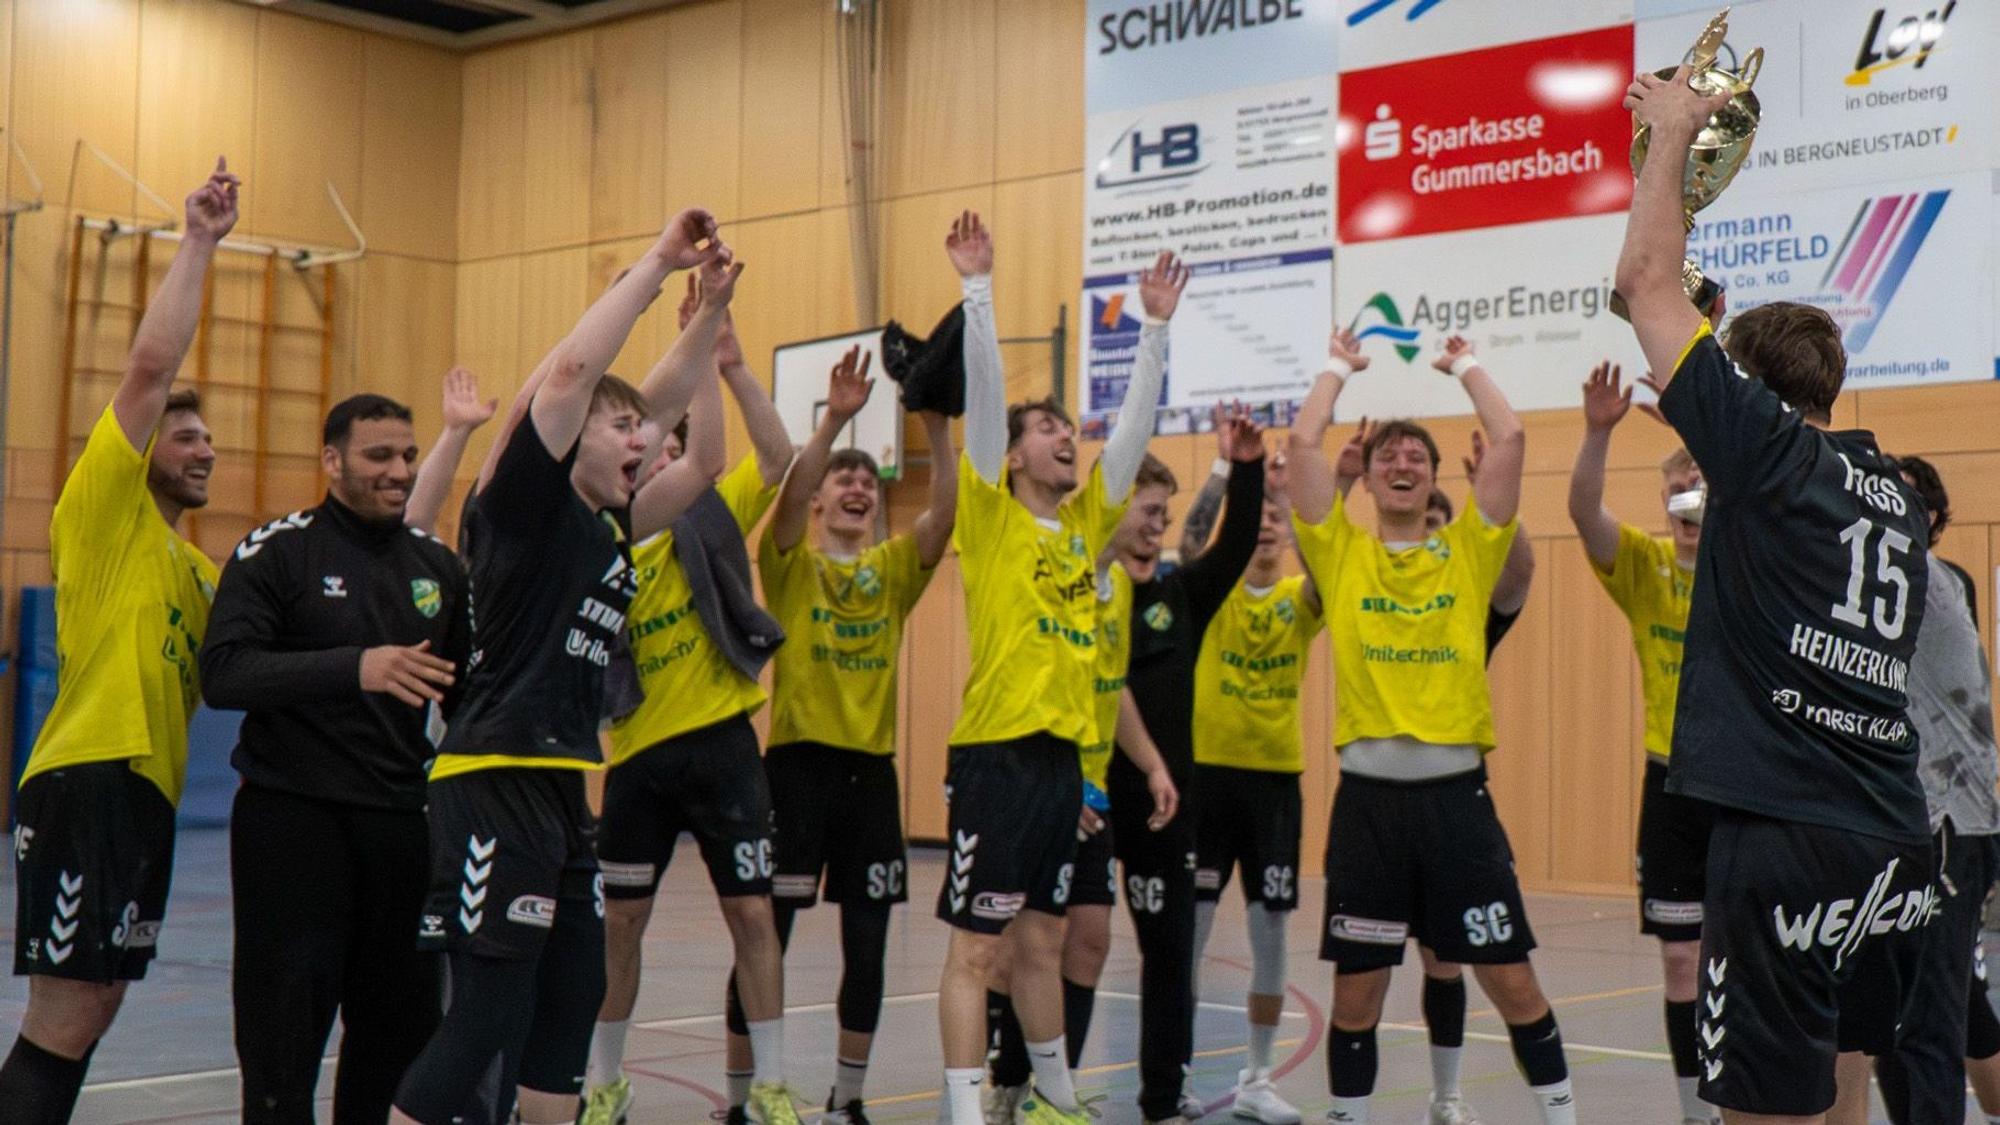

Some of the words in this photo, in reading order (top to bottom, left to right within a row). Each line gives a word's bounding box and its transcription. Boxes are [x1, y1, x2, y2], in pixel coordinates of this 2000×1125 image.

[1098, 0, 1303, 55] SCHWALBE
[1846, 94, 1860, 110] in
[1865, 85, 1948, 107] Oberberg
[1131, 122, 1200, 173] HB
[1410, 113, 1545, 160] Sparkasse
[1758, 150, 1777, 168] IN
[1783, 127, 1944, 164] BERGNEUSTADT
[1410, 140, 1604, 195] Gummersbach
[1091, 181, 1328, 227] www.HB-Promotion.de
[1765, 269, 1791, 286] KG
[1411, 276, 1610, 332] AggerEnergi
[1831, 517, 1913, 640] 15
[734, 838, 774, 882] SC
[867, 862, 904, 899] SC
[1263, 865, 1293, 898] SC
[1129, 874, 1166, 914] SC
[1462, 901, 1513, 946] SC
